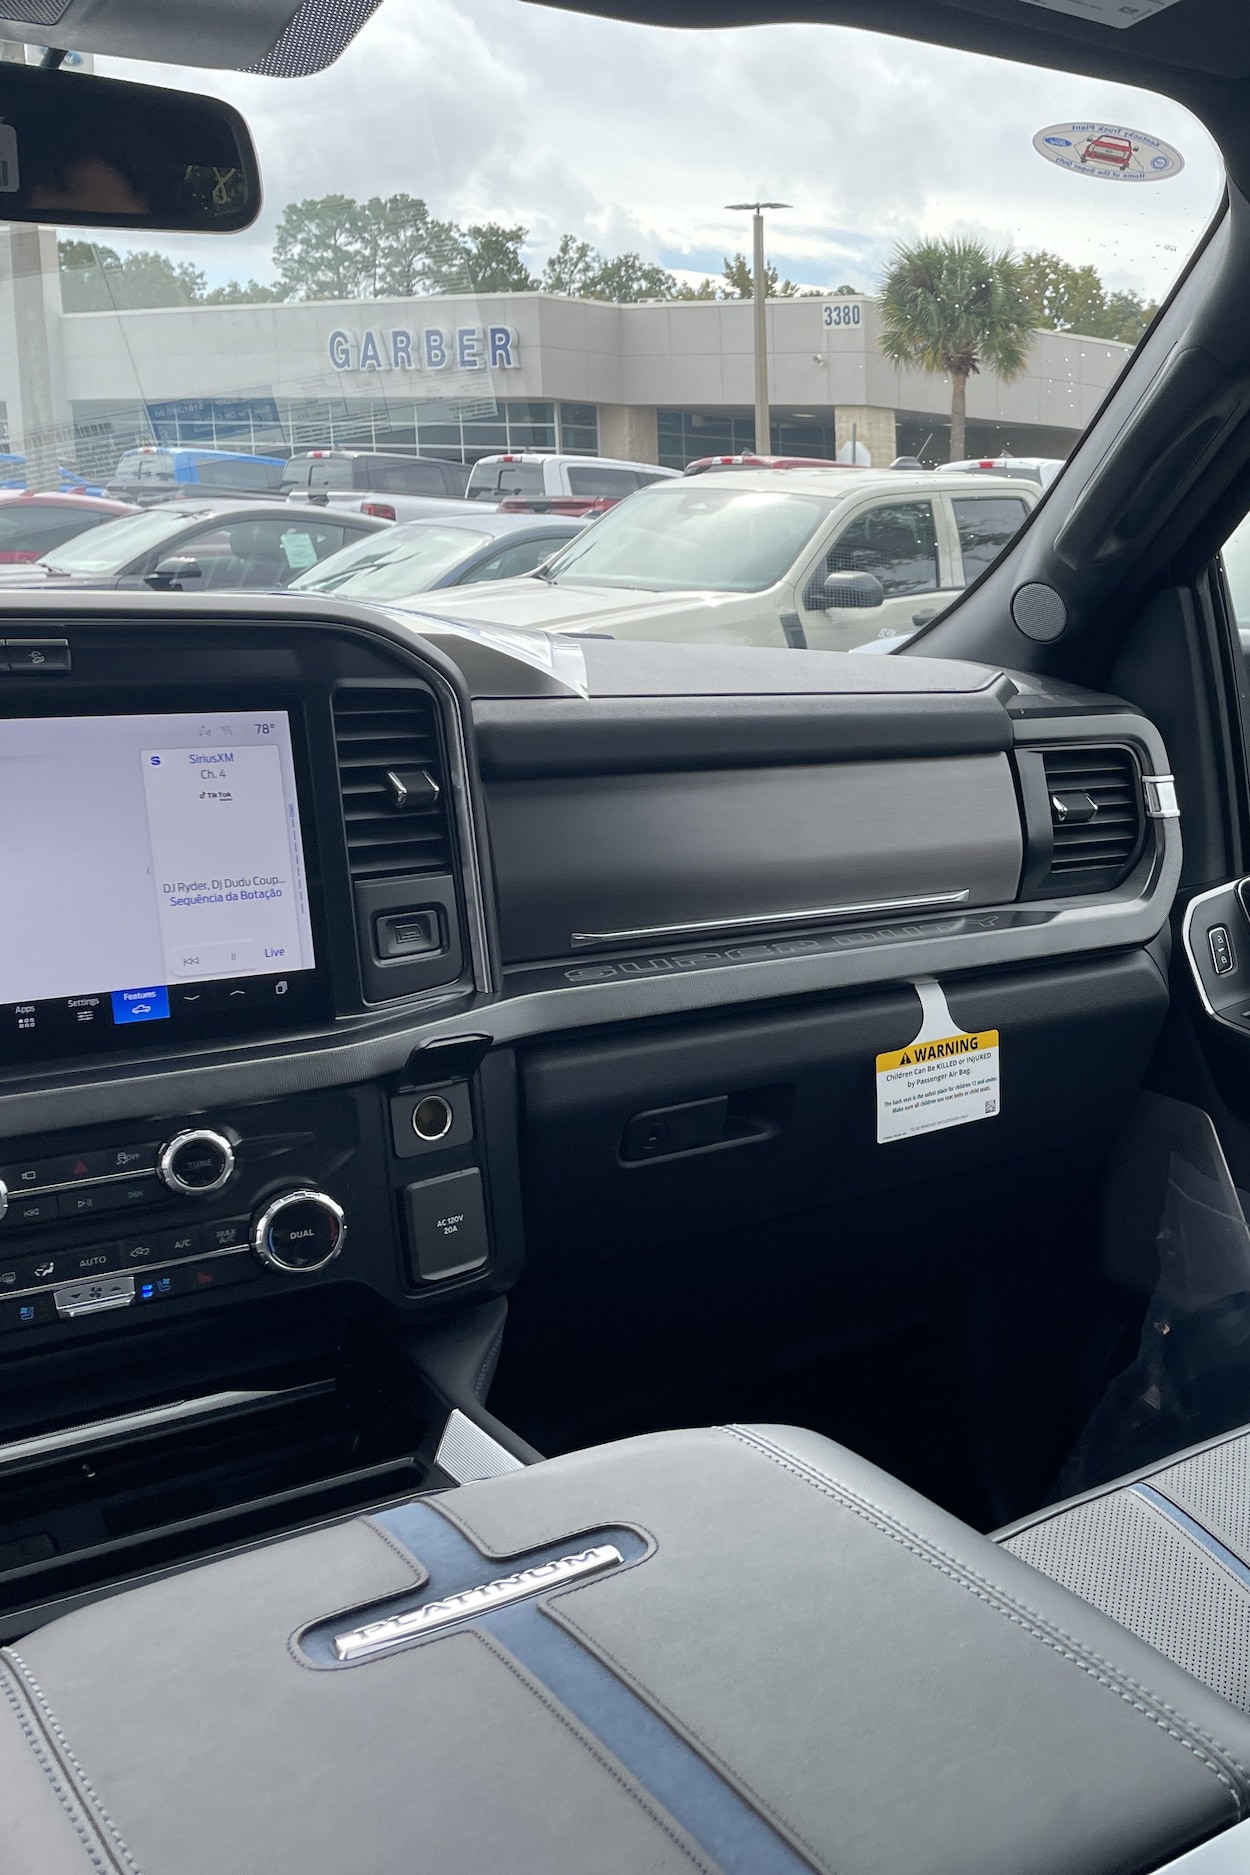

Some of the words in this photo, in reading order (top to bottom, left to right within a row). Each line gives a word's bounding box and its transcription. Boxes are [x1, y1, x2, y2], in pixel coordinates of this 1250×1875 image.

[824, 305, 860, 325] 3380
[328, 325, 520, 372] GARBER
[255, 723, 275, 735] 78°
[189, 753, 234, 764] SiriusXM
[200, 770, 217, 779] Ch.
[219, 769, 226, 778] 4
[163, 884, 176, 894] DJ
[178, 881, 210, 893] Ryder,
[212, 879, 223, 891] Dj
[225, 877, 251, 889] Dudu
[170, 892, 224, 907] Sequência
[225, 892, 239, 902] da
[240, 888, 283, 901] Botação
[265, 948, 285, 958] Live
[564, 939, 820, 982] SUPER
[832, 915, 999, 946] DUTY
[123, 991, 157, 1001] Features
[68, 998, 99, 1008] Settings
[15, 1005, 35, 1015] Apps
[914, 1037, 978, 1063] WARNING
[886, 1071, 913, 1081] Children
[927, 1064, 935, 1072] Be
[936, 1060, 957, 1070] KILLED
[966, 1052, 991, 1063] INJURED
[907, 1080, 915, 1089] by
[916, 1074, 947, 1085] Passenger
[437, 1218, 447, 1227] AC
[447, 1214, 464, 1224] 120V
[216, 1229, 237, 1238] MAX
[290, 1229, 315, 1240] DUAL
[443, 1225, 458, 1235] 20A
[175, 1239, 191, 1249] A/C
[219, 1236, 235, 1244] A/C
[79, 1256, 107, 1268] AUTO
[352, 1548, 602, 1640] PLATINUM
